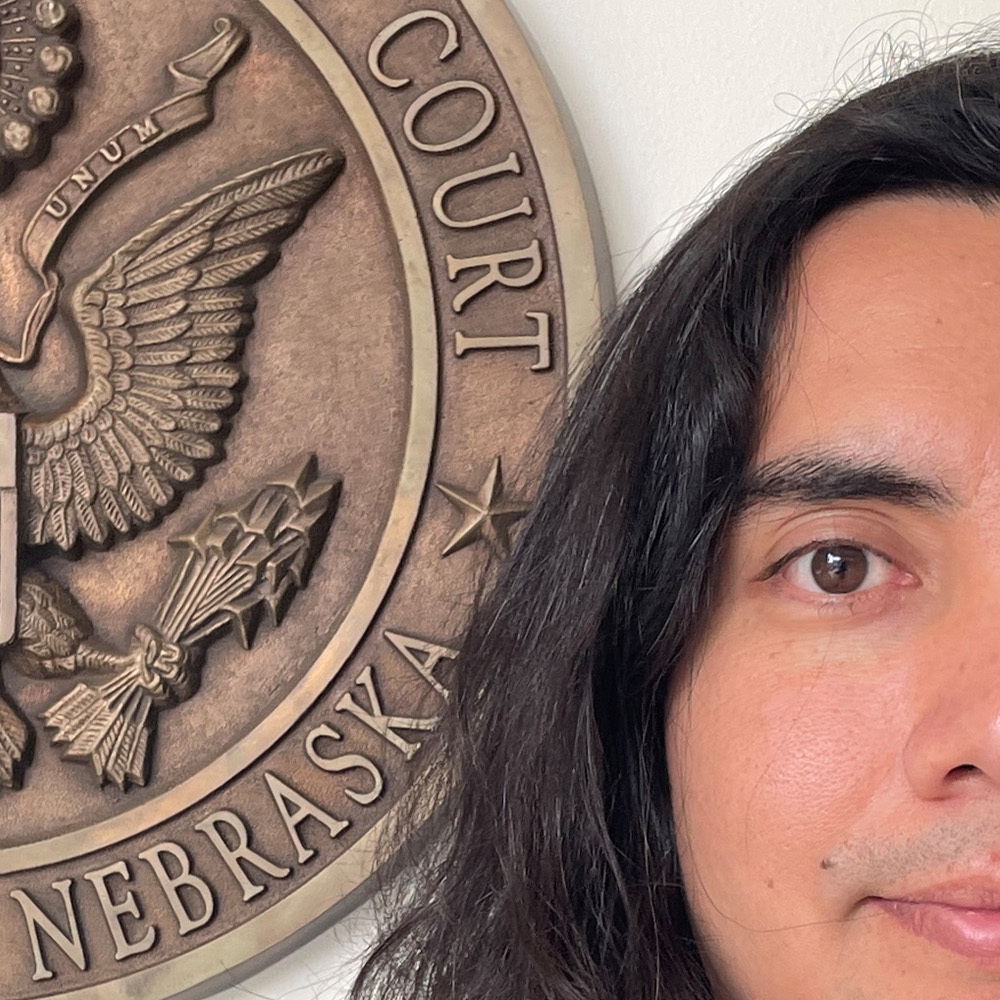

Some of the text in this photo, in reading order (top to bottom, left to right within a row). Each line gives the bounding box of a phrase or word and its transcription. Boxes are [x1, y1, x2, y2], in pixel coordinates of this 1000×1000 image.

[45, 117, 159, 218] UNUM
[368, 10, 551, 371] COURT
[10, 631, 460, 981] NEBRASKA
